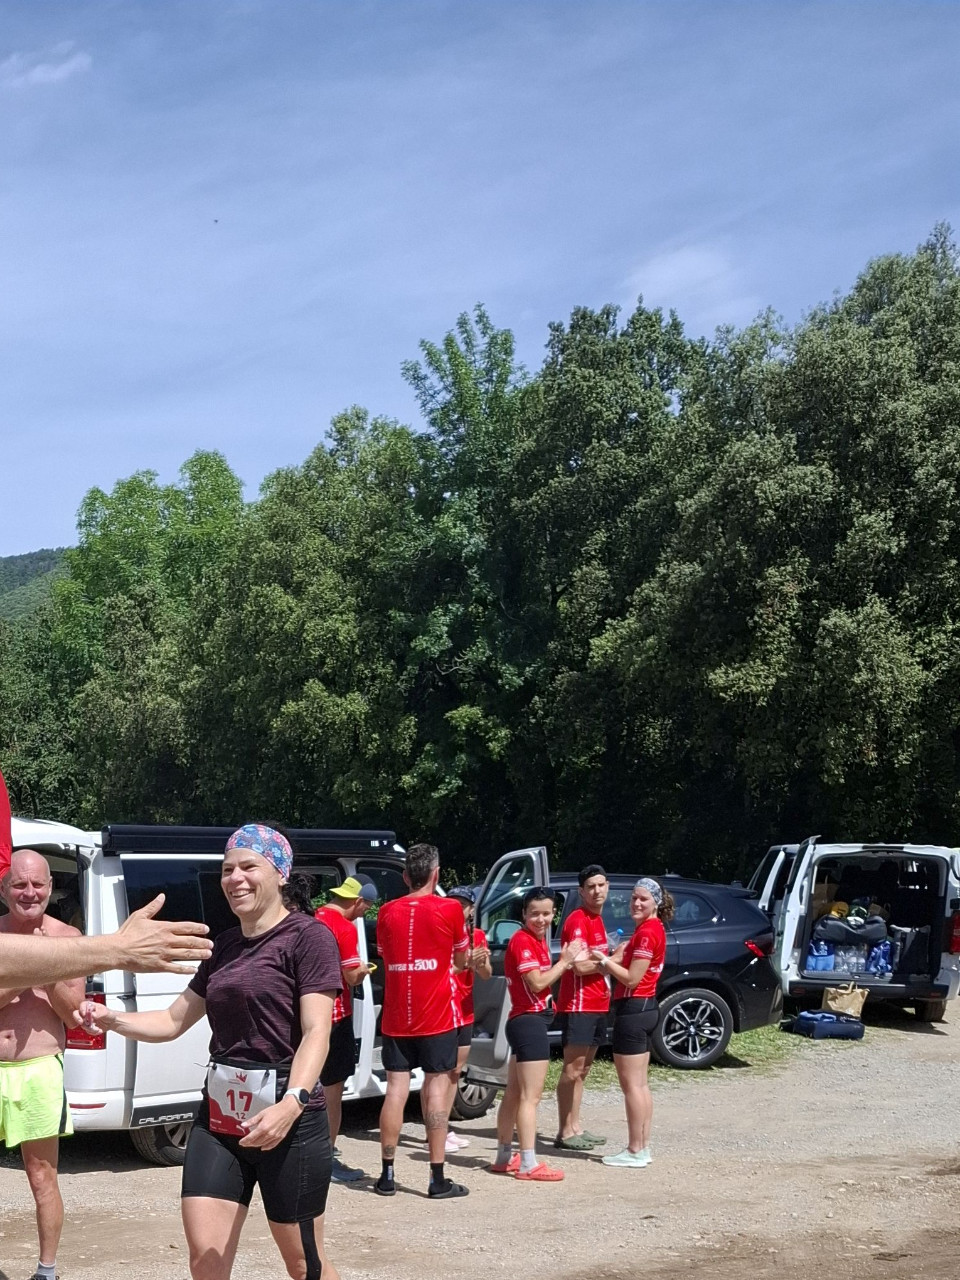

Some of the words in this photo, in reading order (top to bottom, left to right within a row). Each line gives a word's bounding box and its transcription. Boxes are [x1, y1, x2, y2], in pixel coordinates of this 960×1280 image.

[226, 1088, 253, 1112] 17
[138, 1112, 193, 1125] CALIFORNIA
[235, 1112, 246, 1120] 12
